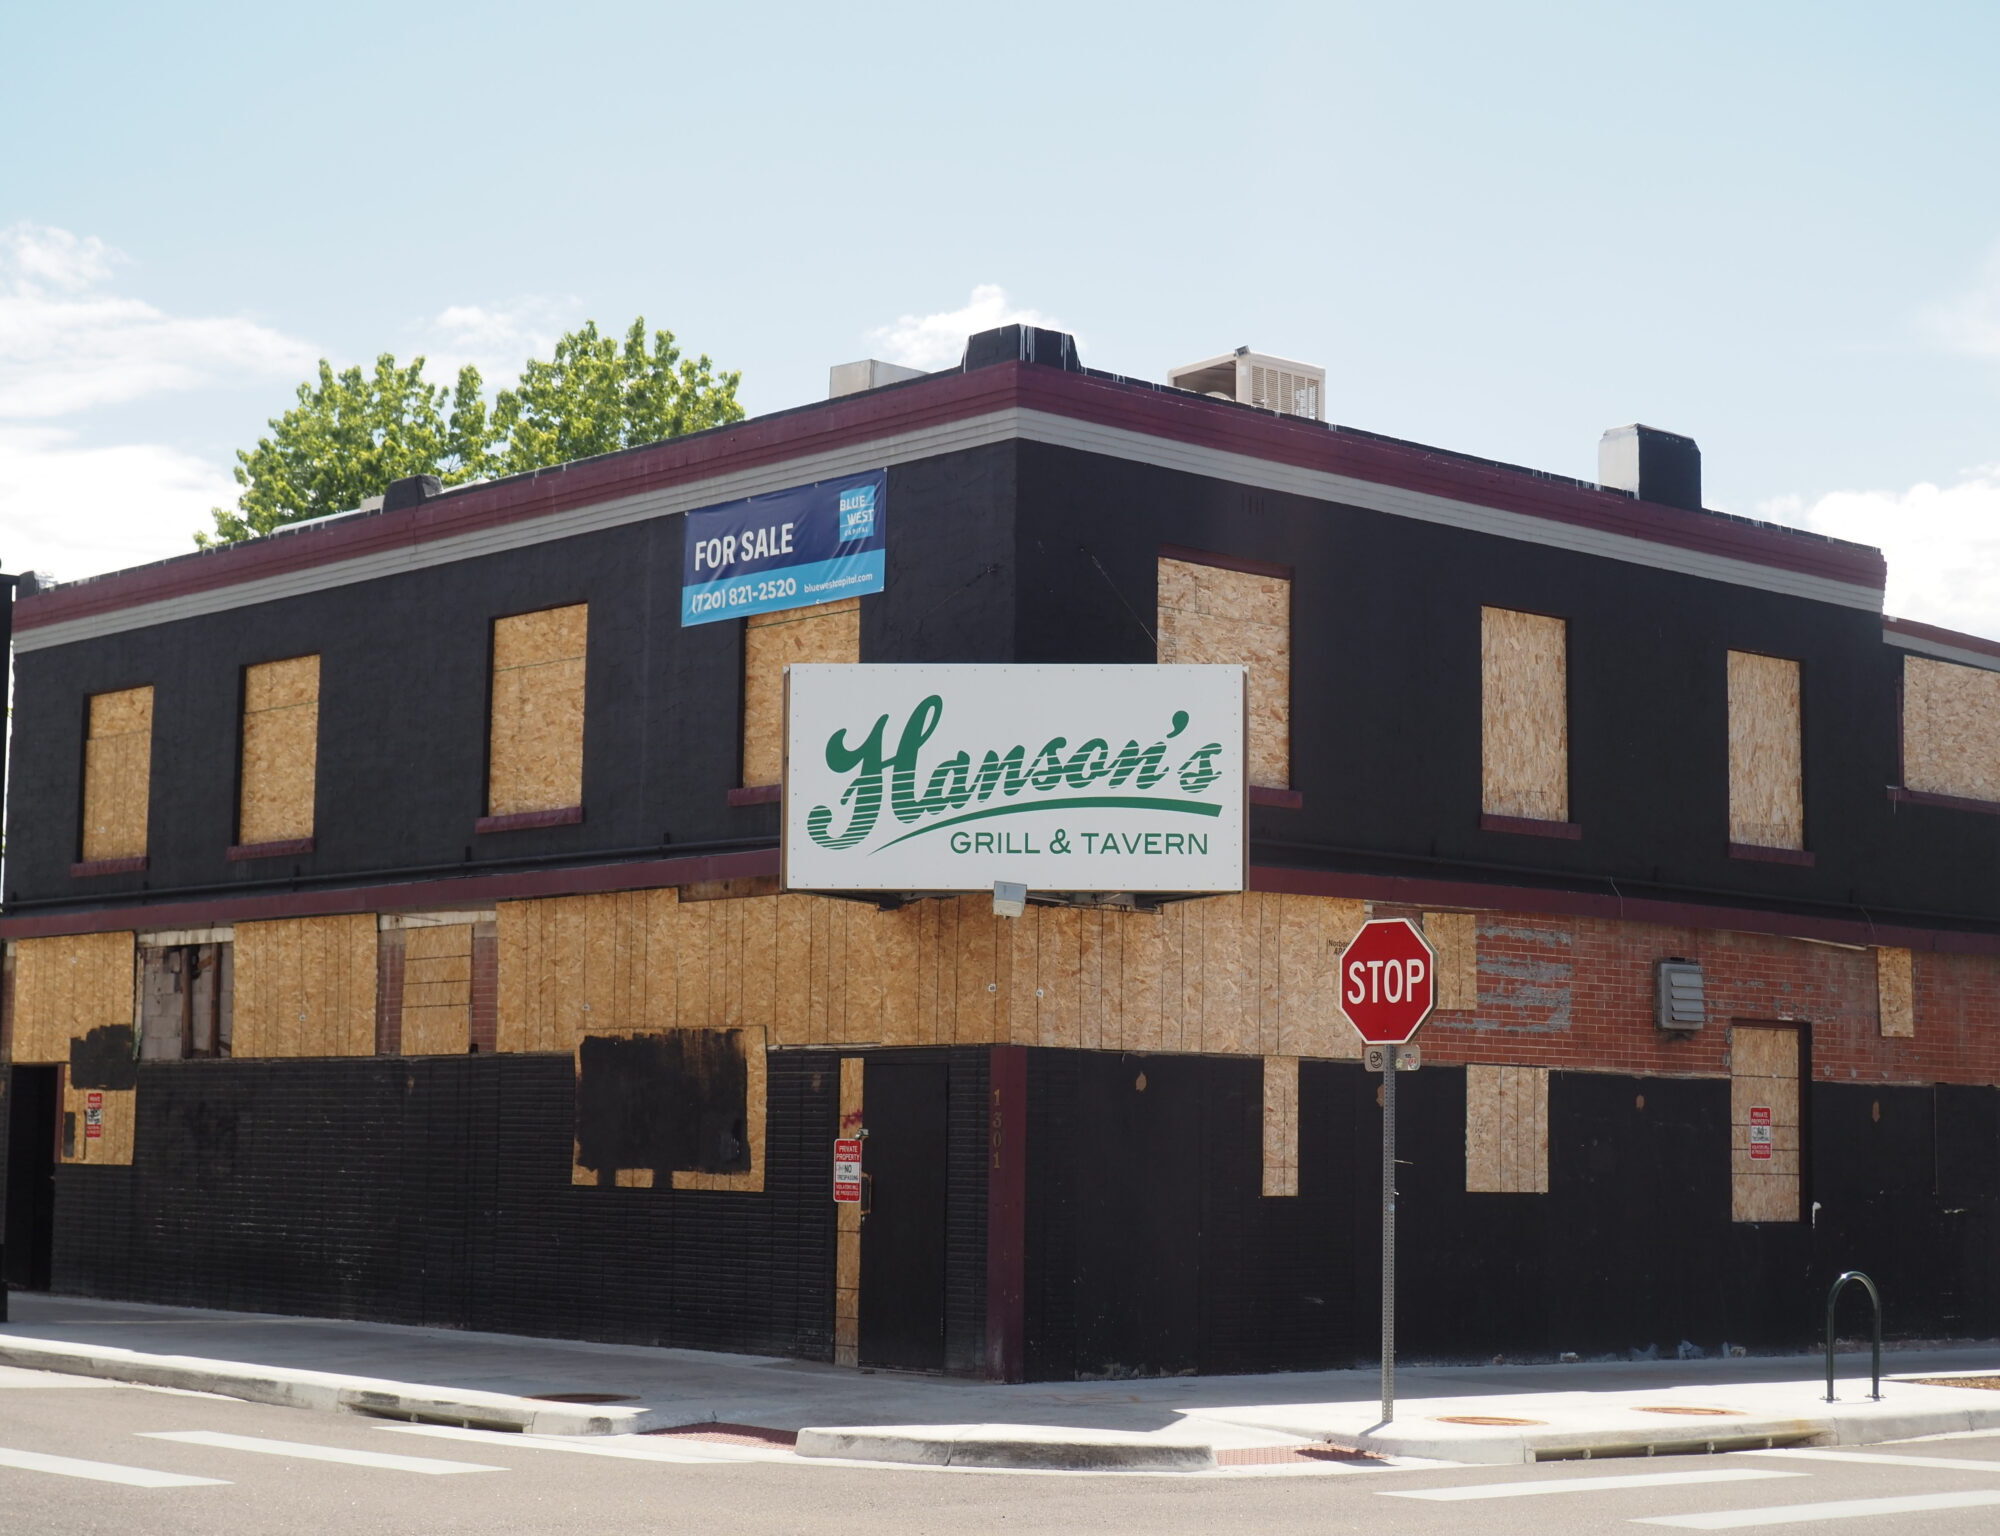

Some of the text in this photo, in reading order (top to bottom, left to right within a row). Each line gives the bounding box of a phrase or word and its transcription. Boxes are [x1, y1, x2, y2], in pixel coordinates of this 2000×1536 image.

[840, 495, 866, 511] BLUE
[847, 509, 875, 526] WEST
[694, 523, 794, 571] FOR SALE
[691, 577, 797, 614] (720) 821-2520
[803, 573, 873, 593] bluewestcapital.com
[807, 694, 1223, 850] Hanson's
[950, 828, 1208, 855] GRILL & TAVERN
[1347, 958, 1425, 1005] STOP
[844, 1165, 852, 1174] NO
